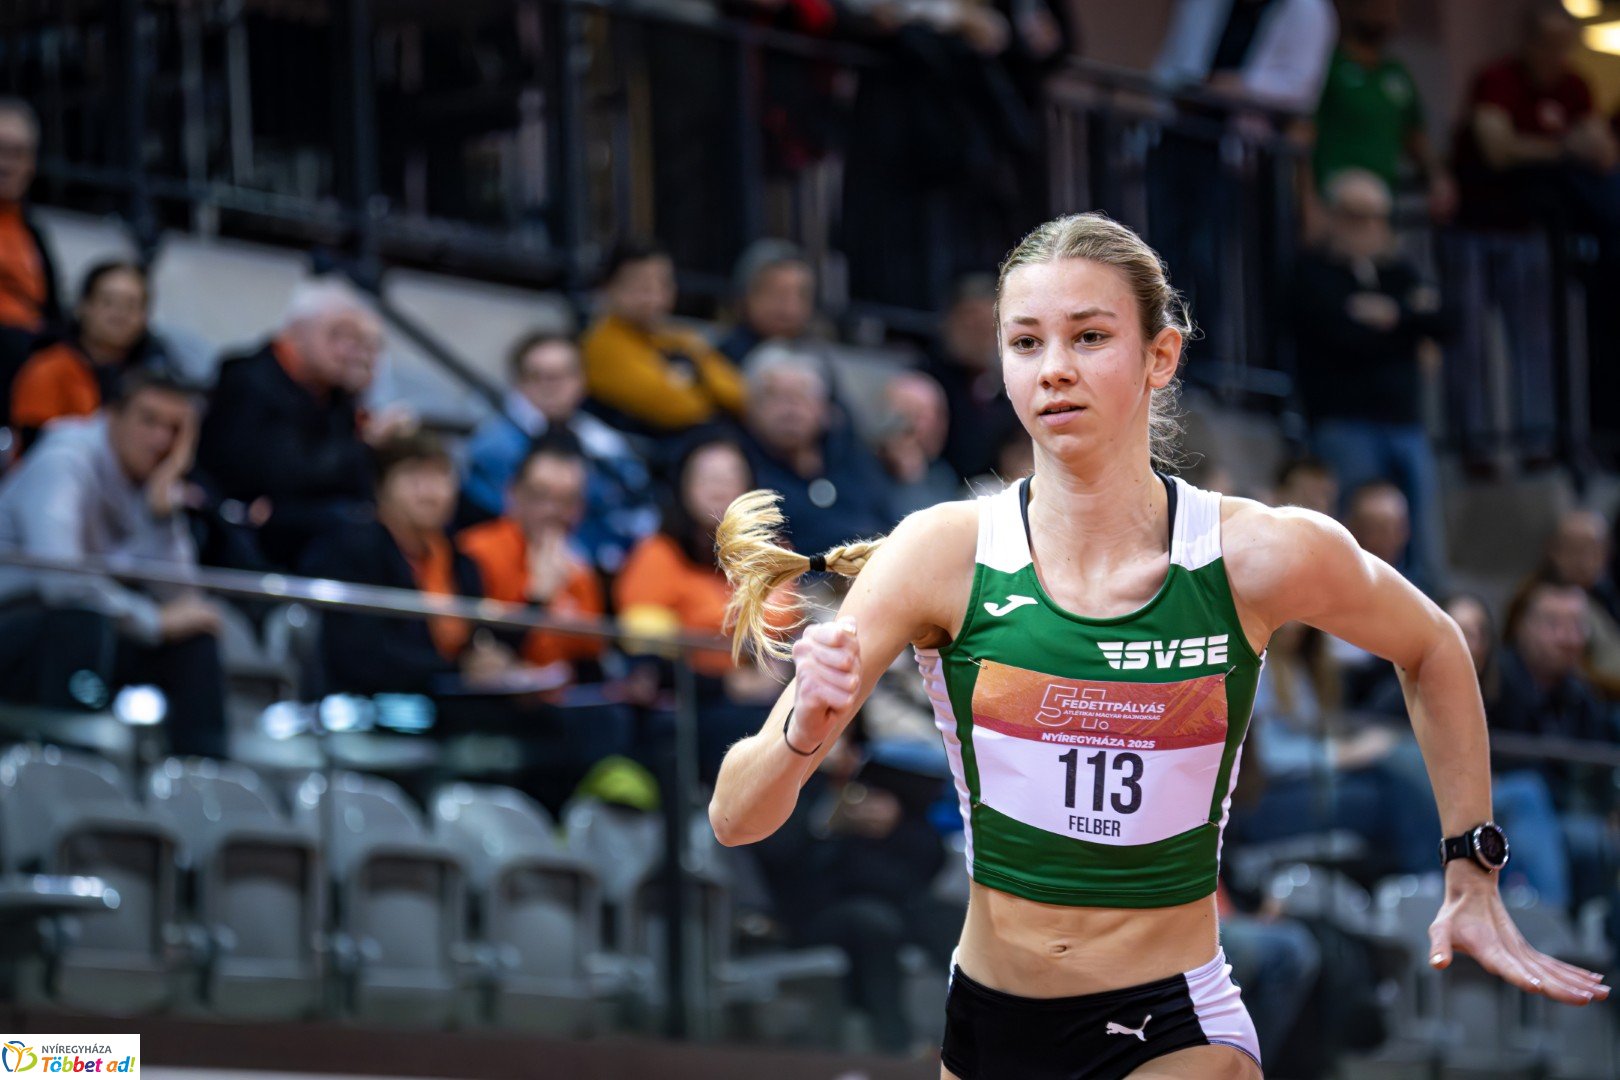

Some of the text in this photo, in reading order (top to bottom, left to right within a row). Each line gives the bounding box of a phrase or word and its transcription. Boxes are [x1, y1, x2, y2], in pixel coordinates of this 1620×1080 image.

[1062, 699, 1165, 714] FEDETTPÁLYÁS
[1041, 732, 1156, 748] NYÍREGYHÁZA 2025
[1058, 748, 1144, 815] 113
[1069, 815, 1121, 837] FELBER
